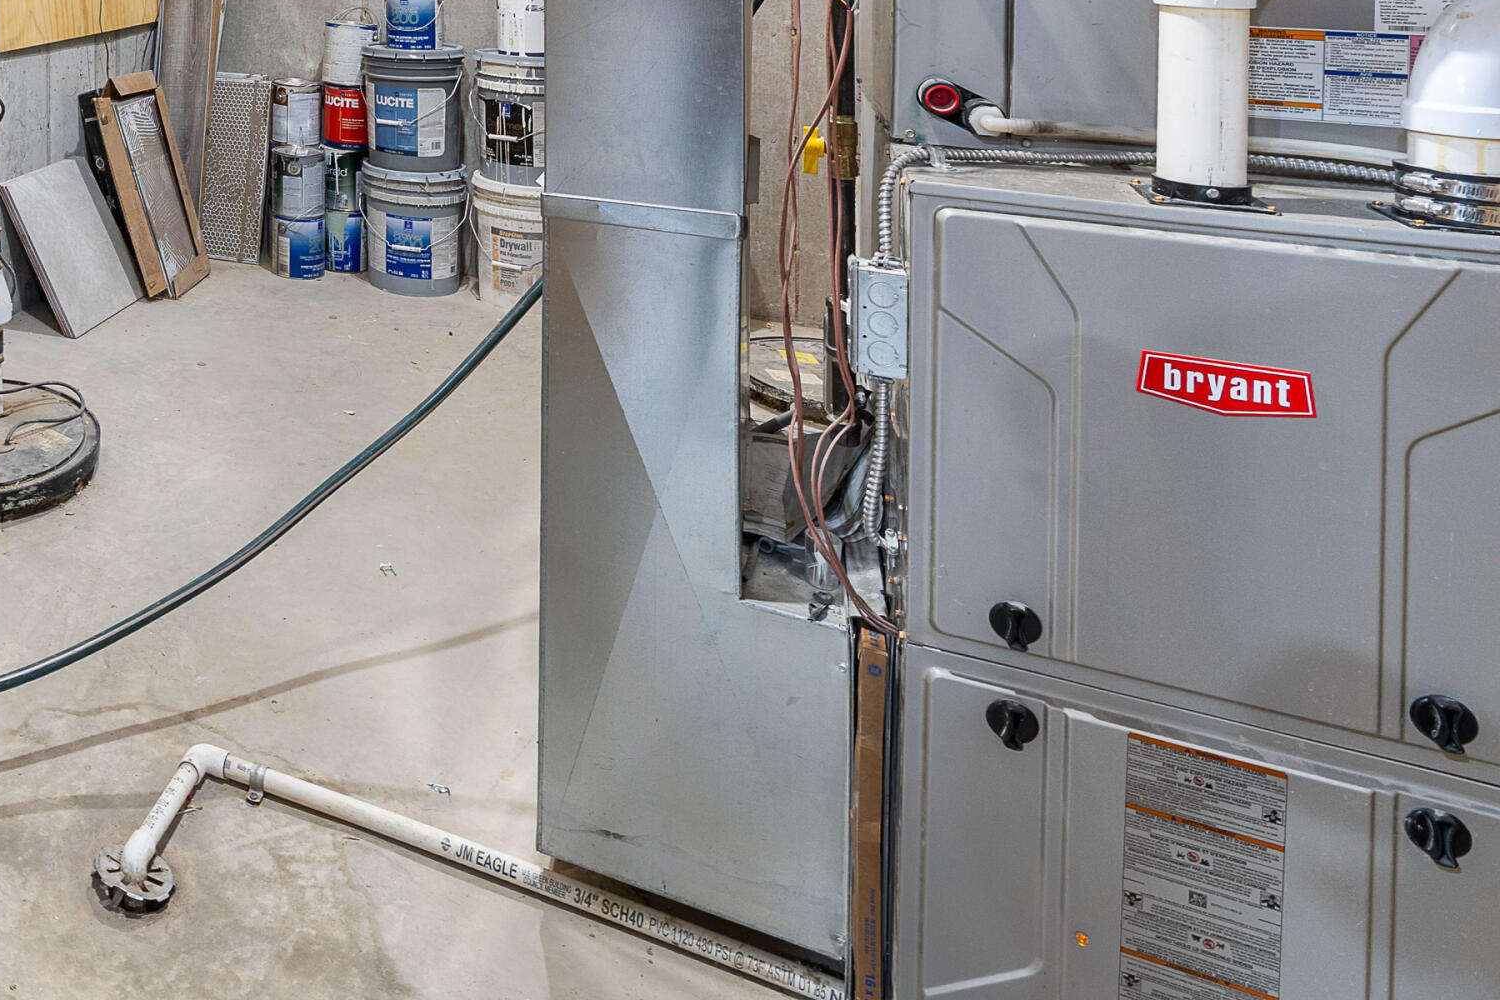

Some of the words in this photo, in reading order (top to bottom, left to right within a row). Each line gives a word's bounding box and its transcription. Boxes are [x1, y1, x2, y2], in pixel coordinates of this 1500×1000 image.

[324, 93, 360, 109] LUCITE
[376, 93, 415, 109] LUCITE
[500, 238, 532, 252] Drywall
[1163, 362, 1292, 408] bryant
[456, 844, 474, 862] JM
[475, 850, 518, 879] EAGLE
[573, 887, 599, 907] 3/4"
[601, 899, 644, 928] SCH40
[649, 916, 670, 937] PVC
[671, 926, 695, 947] 1120
[695, 938, 713, 955] 480
[714, 942, 733, 962] PSI
[734, 952, 745, 969] @
[767, 962, 796, 987] ASTM
